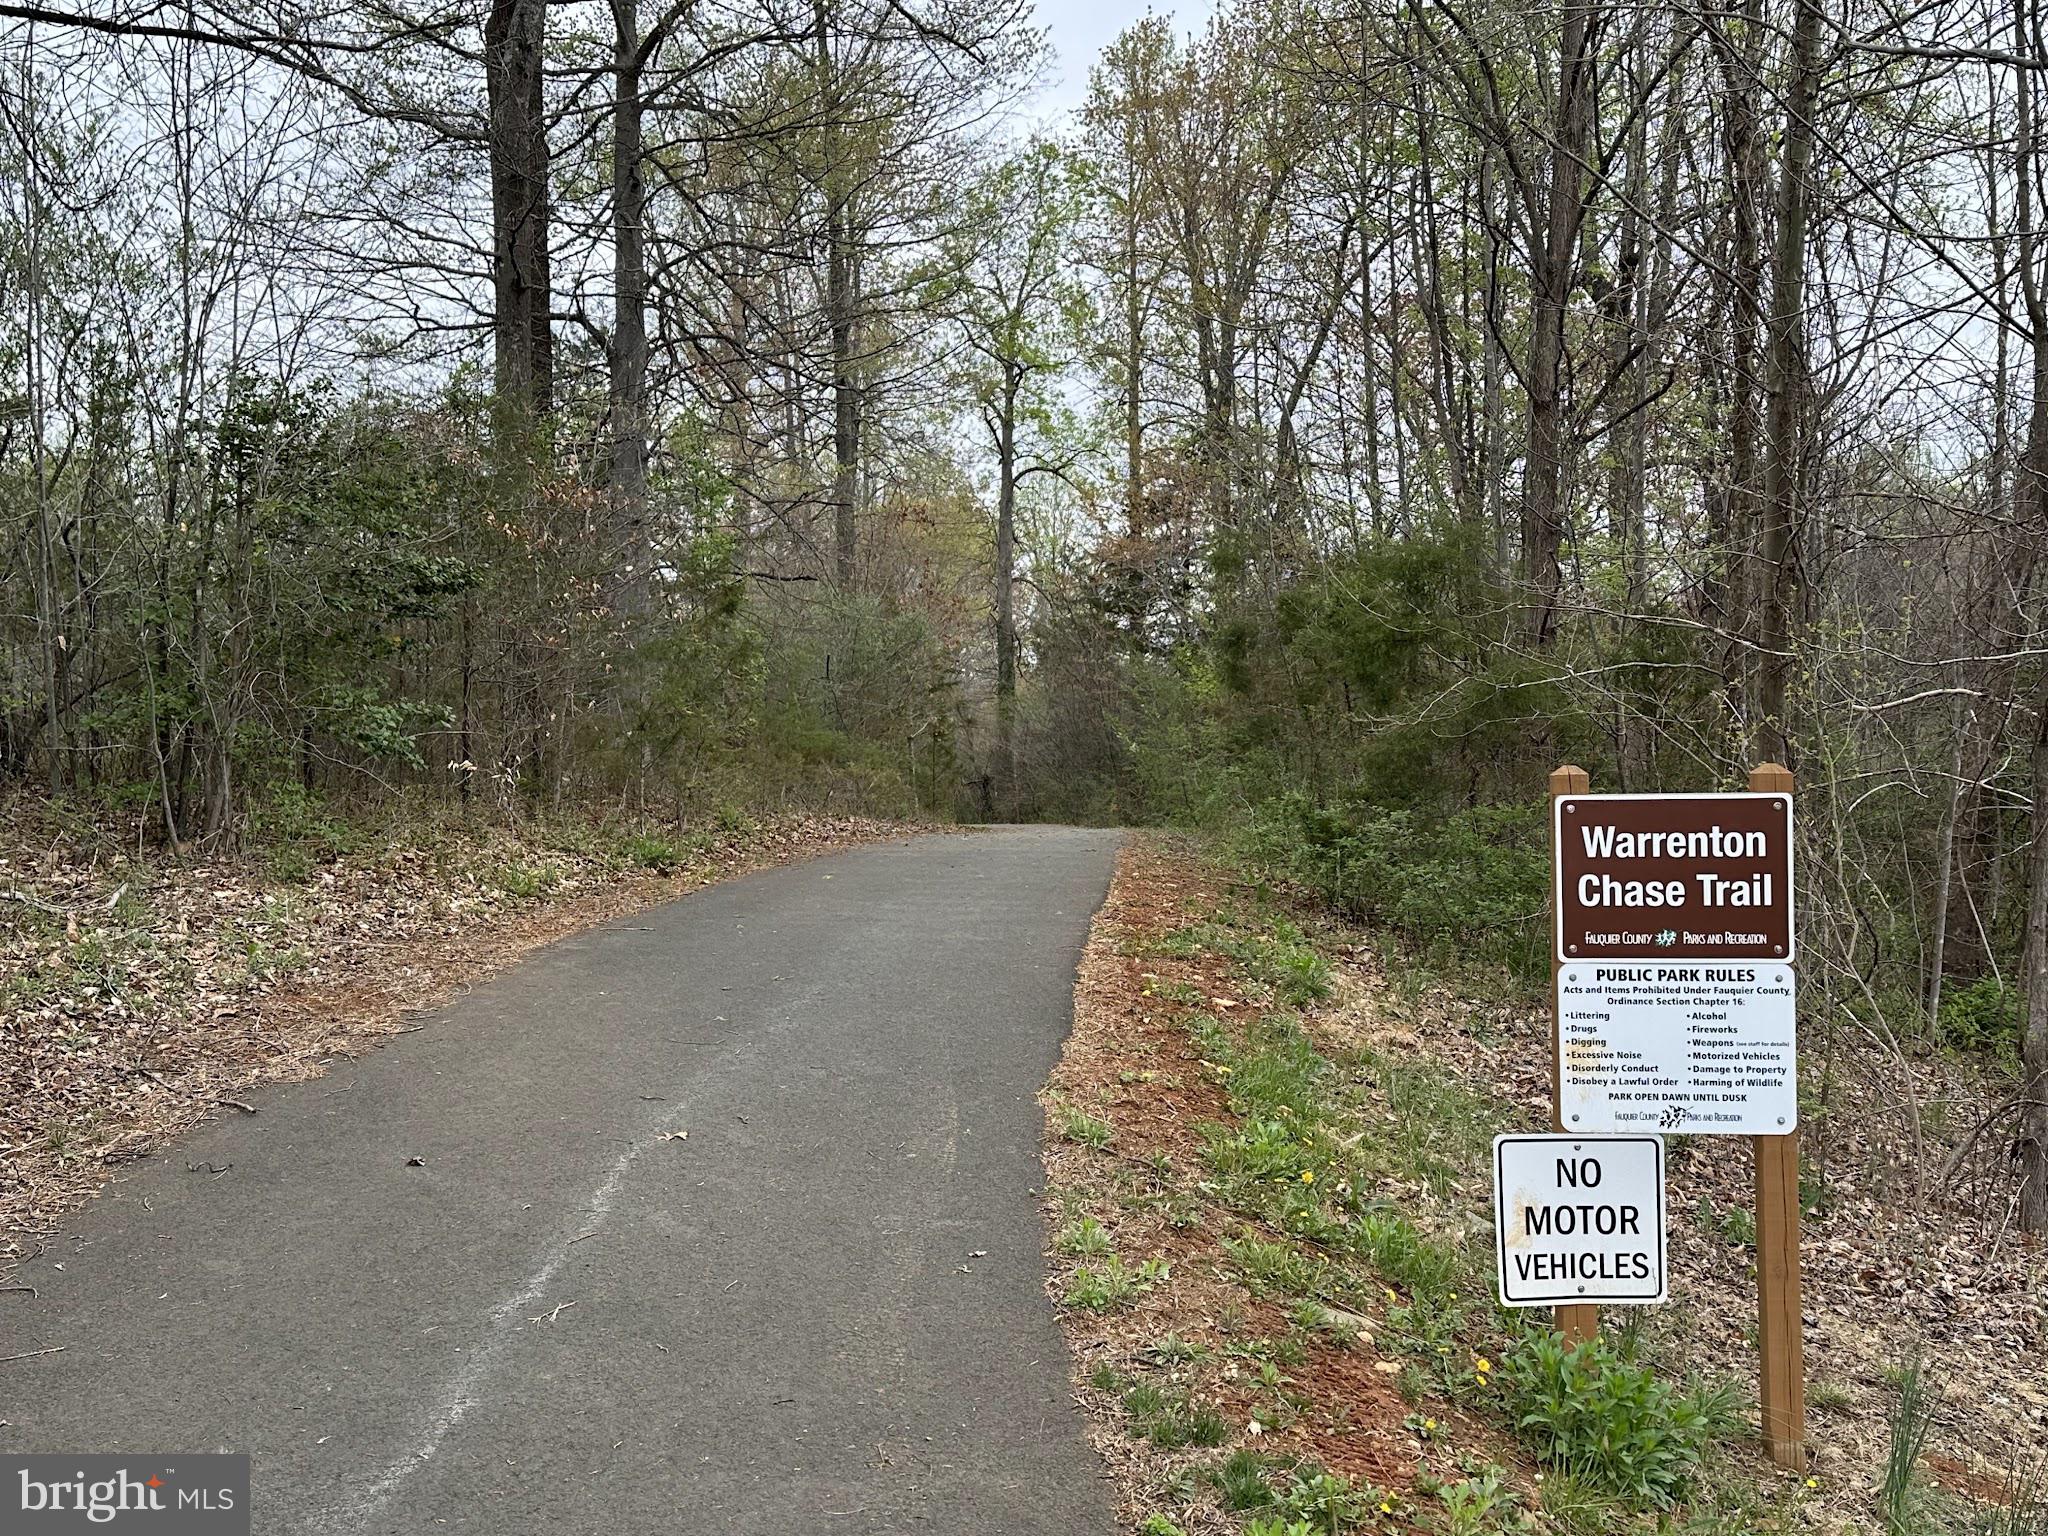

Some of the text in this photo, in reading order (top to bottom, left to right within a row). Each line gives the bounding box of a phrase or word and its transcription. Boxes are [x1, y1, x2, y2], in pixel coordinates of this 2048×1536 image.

[1581, 825, 1767, 858] Warrenton
[1578, 873, 1773, 907] Chase Trail
[1622, 931, 1653, 945] COUNTY
[1683, 931, 1706, 945] PARKS
[1707, 933, 1723, 945] AND
[1725, 931, 1767, 945] RECREATION
[1596, 969, 1756, 982] PUBLIC PARK RULES
[1714, 986, 1754, 995] Fauquier
[1608, 997, 1653, 1005] Ordinance
[1693, 998, 1729, 1007] Chapter
[1733, 998, 1745, 1006] 16:
[1570, 1012, 1610, 1021] Littering
[1692, 1012, 1726, 1020] Alcohol
[1571, 1025, 1597, 1034] Drugs
[1692, 1025, 1738, 1033] Fireworks
[1571, 1038, 1607, 1047] Digging
[1692, 1039, 1734, 1048] Weapons
[1572, 1051, 1614, 1059] Excessive
[1693, 1052, 1740, 1060] Motorized
[1572, 1064, 1619, 1073] Disorderly
[1693, 1065, 1730, 1074] Damage
[1746, 1066, 1786, 1075] Property
[1572, 1077, 1608, 1086] Disobey
[1693, 1079, 1732, 1088] Harming
[1747, 1079, 1783, 1087] Wildlife
[1662, 1093, 1690, 1101] DAWN
[1722, 1094, 1747, 1102] DUSK
[1556, 1158, 1602, 1188] NO
[1525, 1205, 1640, 1235] MOTOR
[1515, 1252, 1649, 1280] VEHICLES
